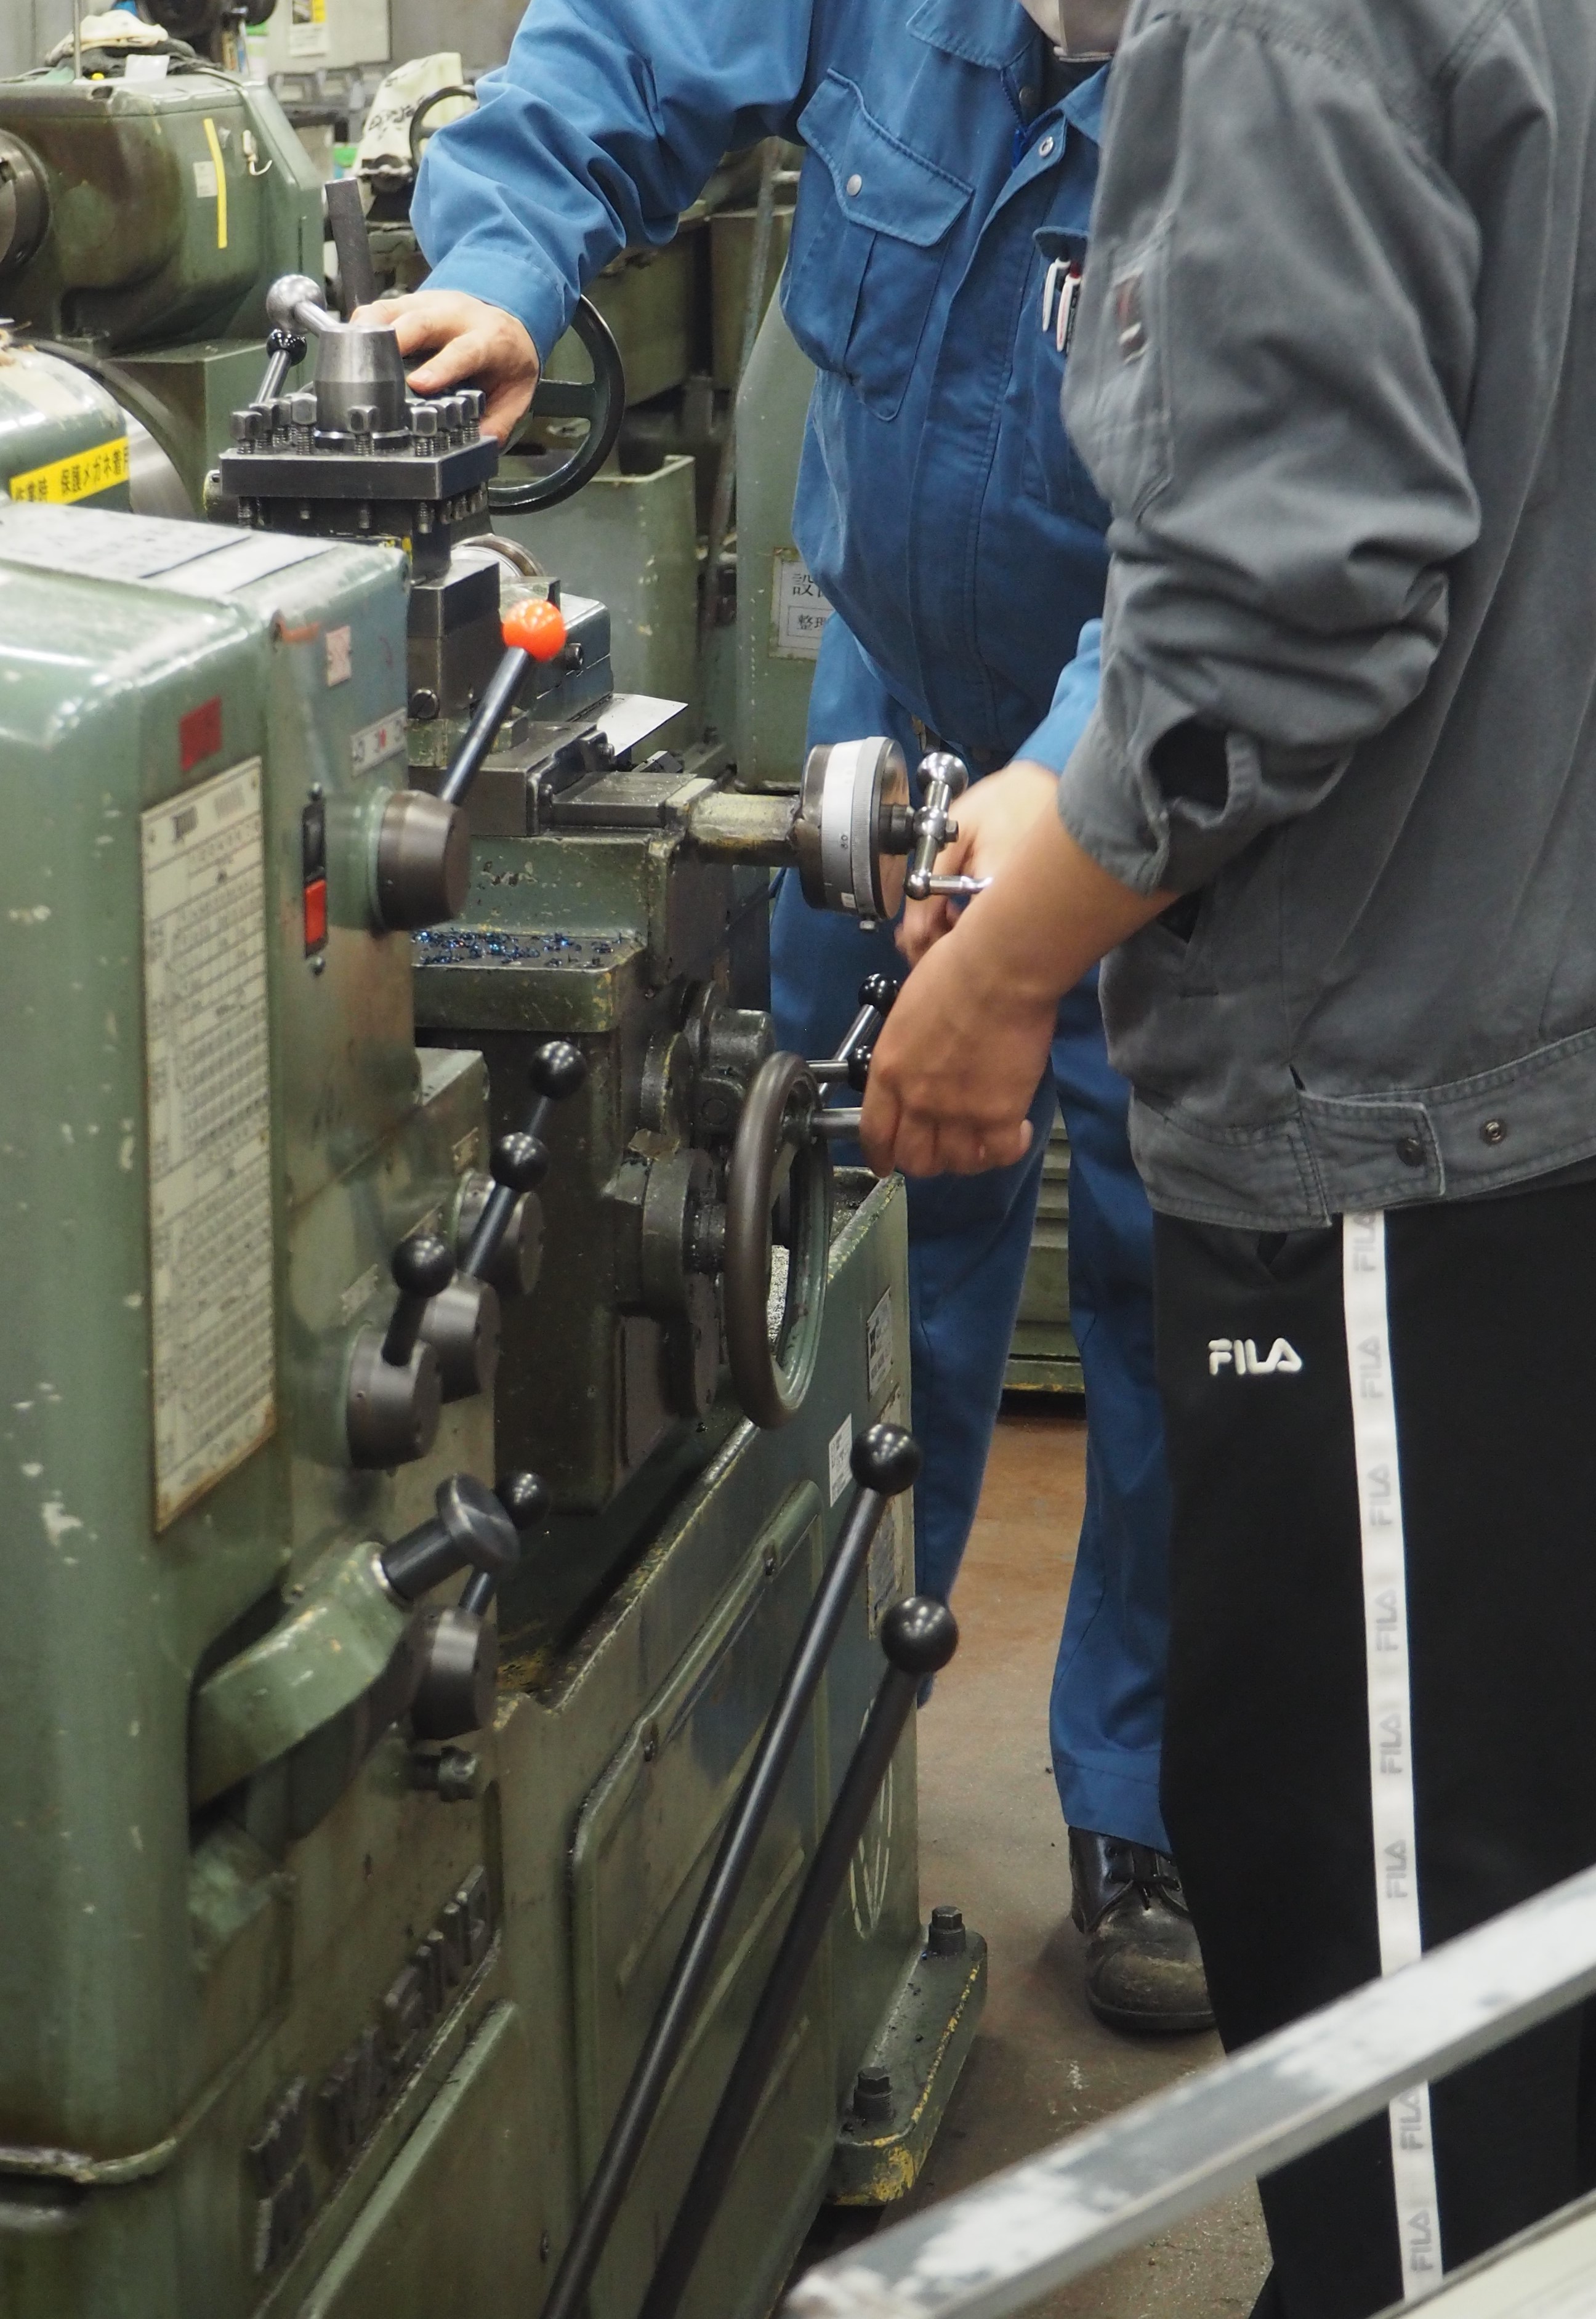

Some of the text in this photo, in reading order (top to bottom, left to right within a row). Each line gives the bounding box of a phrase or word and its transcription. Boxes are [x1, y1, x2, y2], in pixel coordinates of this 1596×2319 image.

[792, 573, 824, 598] 設
[1208, 1337, 1303, 1376] FILA
[1357, 1335, 1384, 1398] FILA
[1367, 1463, 1393, 1527] FILA
[1375, 1589, 1399, 1652] FILA
[1379, 1713, 1403, 1774] FILA
[1384, 1838, 1408, 1899] FILA
[1407, 2210, 1434, 2272] FILA
